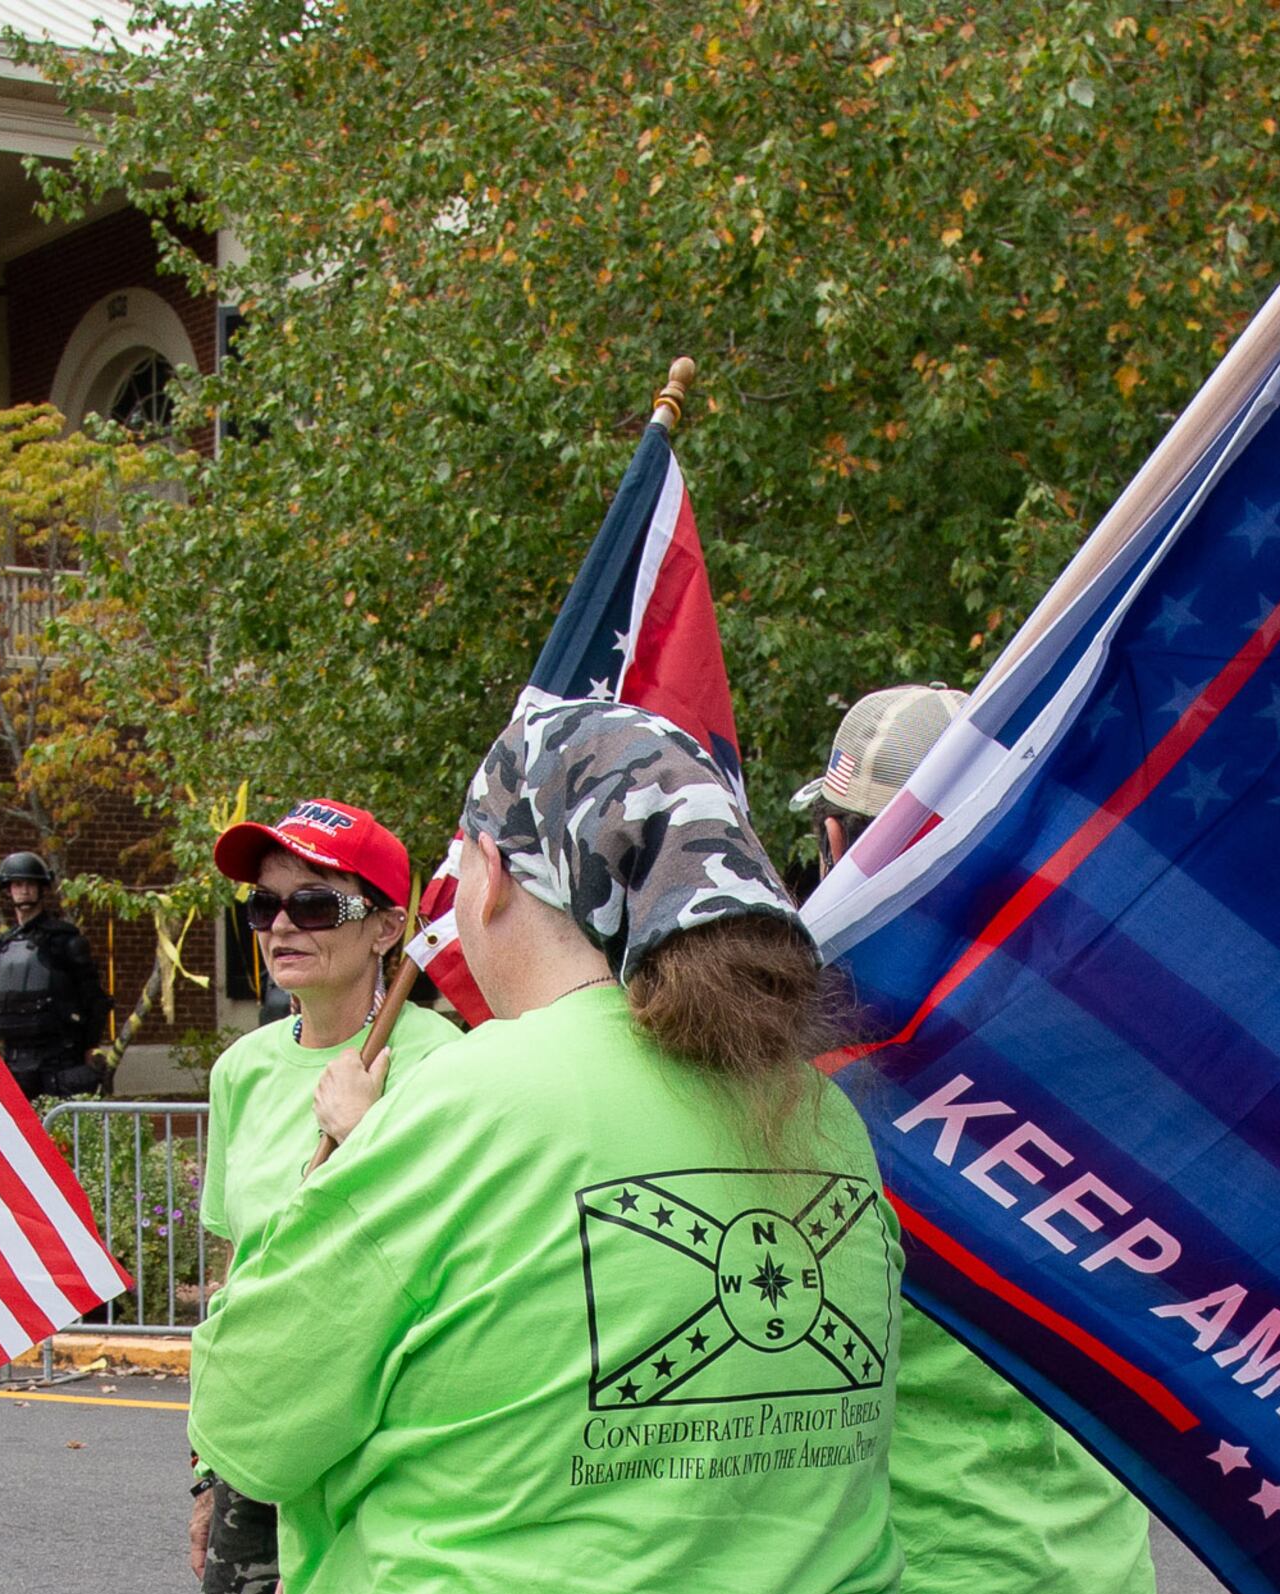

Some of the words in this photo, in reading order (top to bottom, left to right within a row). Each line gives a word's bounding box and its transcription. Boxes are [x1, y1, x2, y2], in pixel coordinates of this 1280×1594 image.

[891, 1073, 1182, 1275] KEEP
[752, 1222, 777, 1245] N
[721, 1274, 743, 1294] W
[801, 1268, 818, 1289] E
[766, 1317, 786, 1341] S
[583, 1416, 755, 1450] CONFEDERATE
[757, 1402, 838, 1437] PATRIOT
[840, 1396, 883, 1429] REBELS
[570, 1454, 666, 1487] BREATHING
[668, 1456, 706, 1480] LIFE
[707, 1454, 741, 1480] BACK
[742, 1450, 771, 1476] INTO
[773, 1447, 798, 1471] THE
[797, 1437, 856, 1469] AMERICAN
